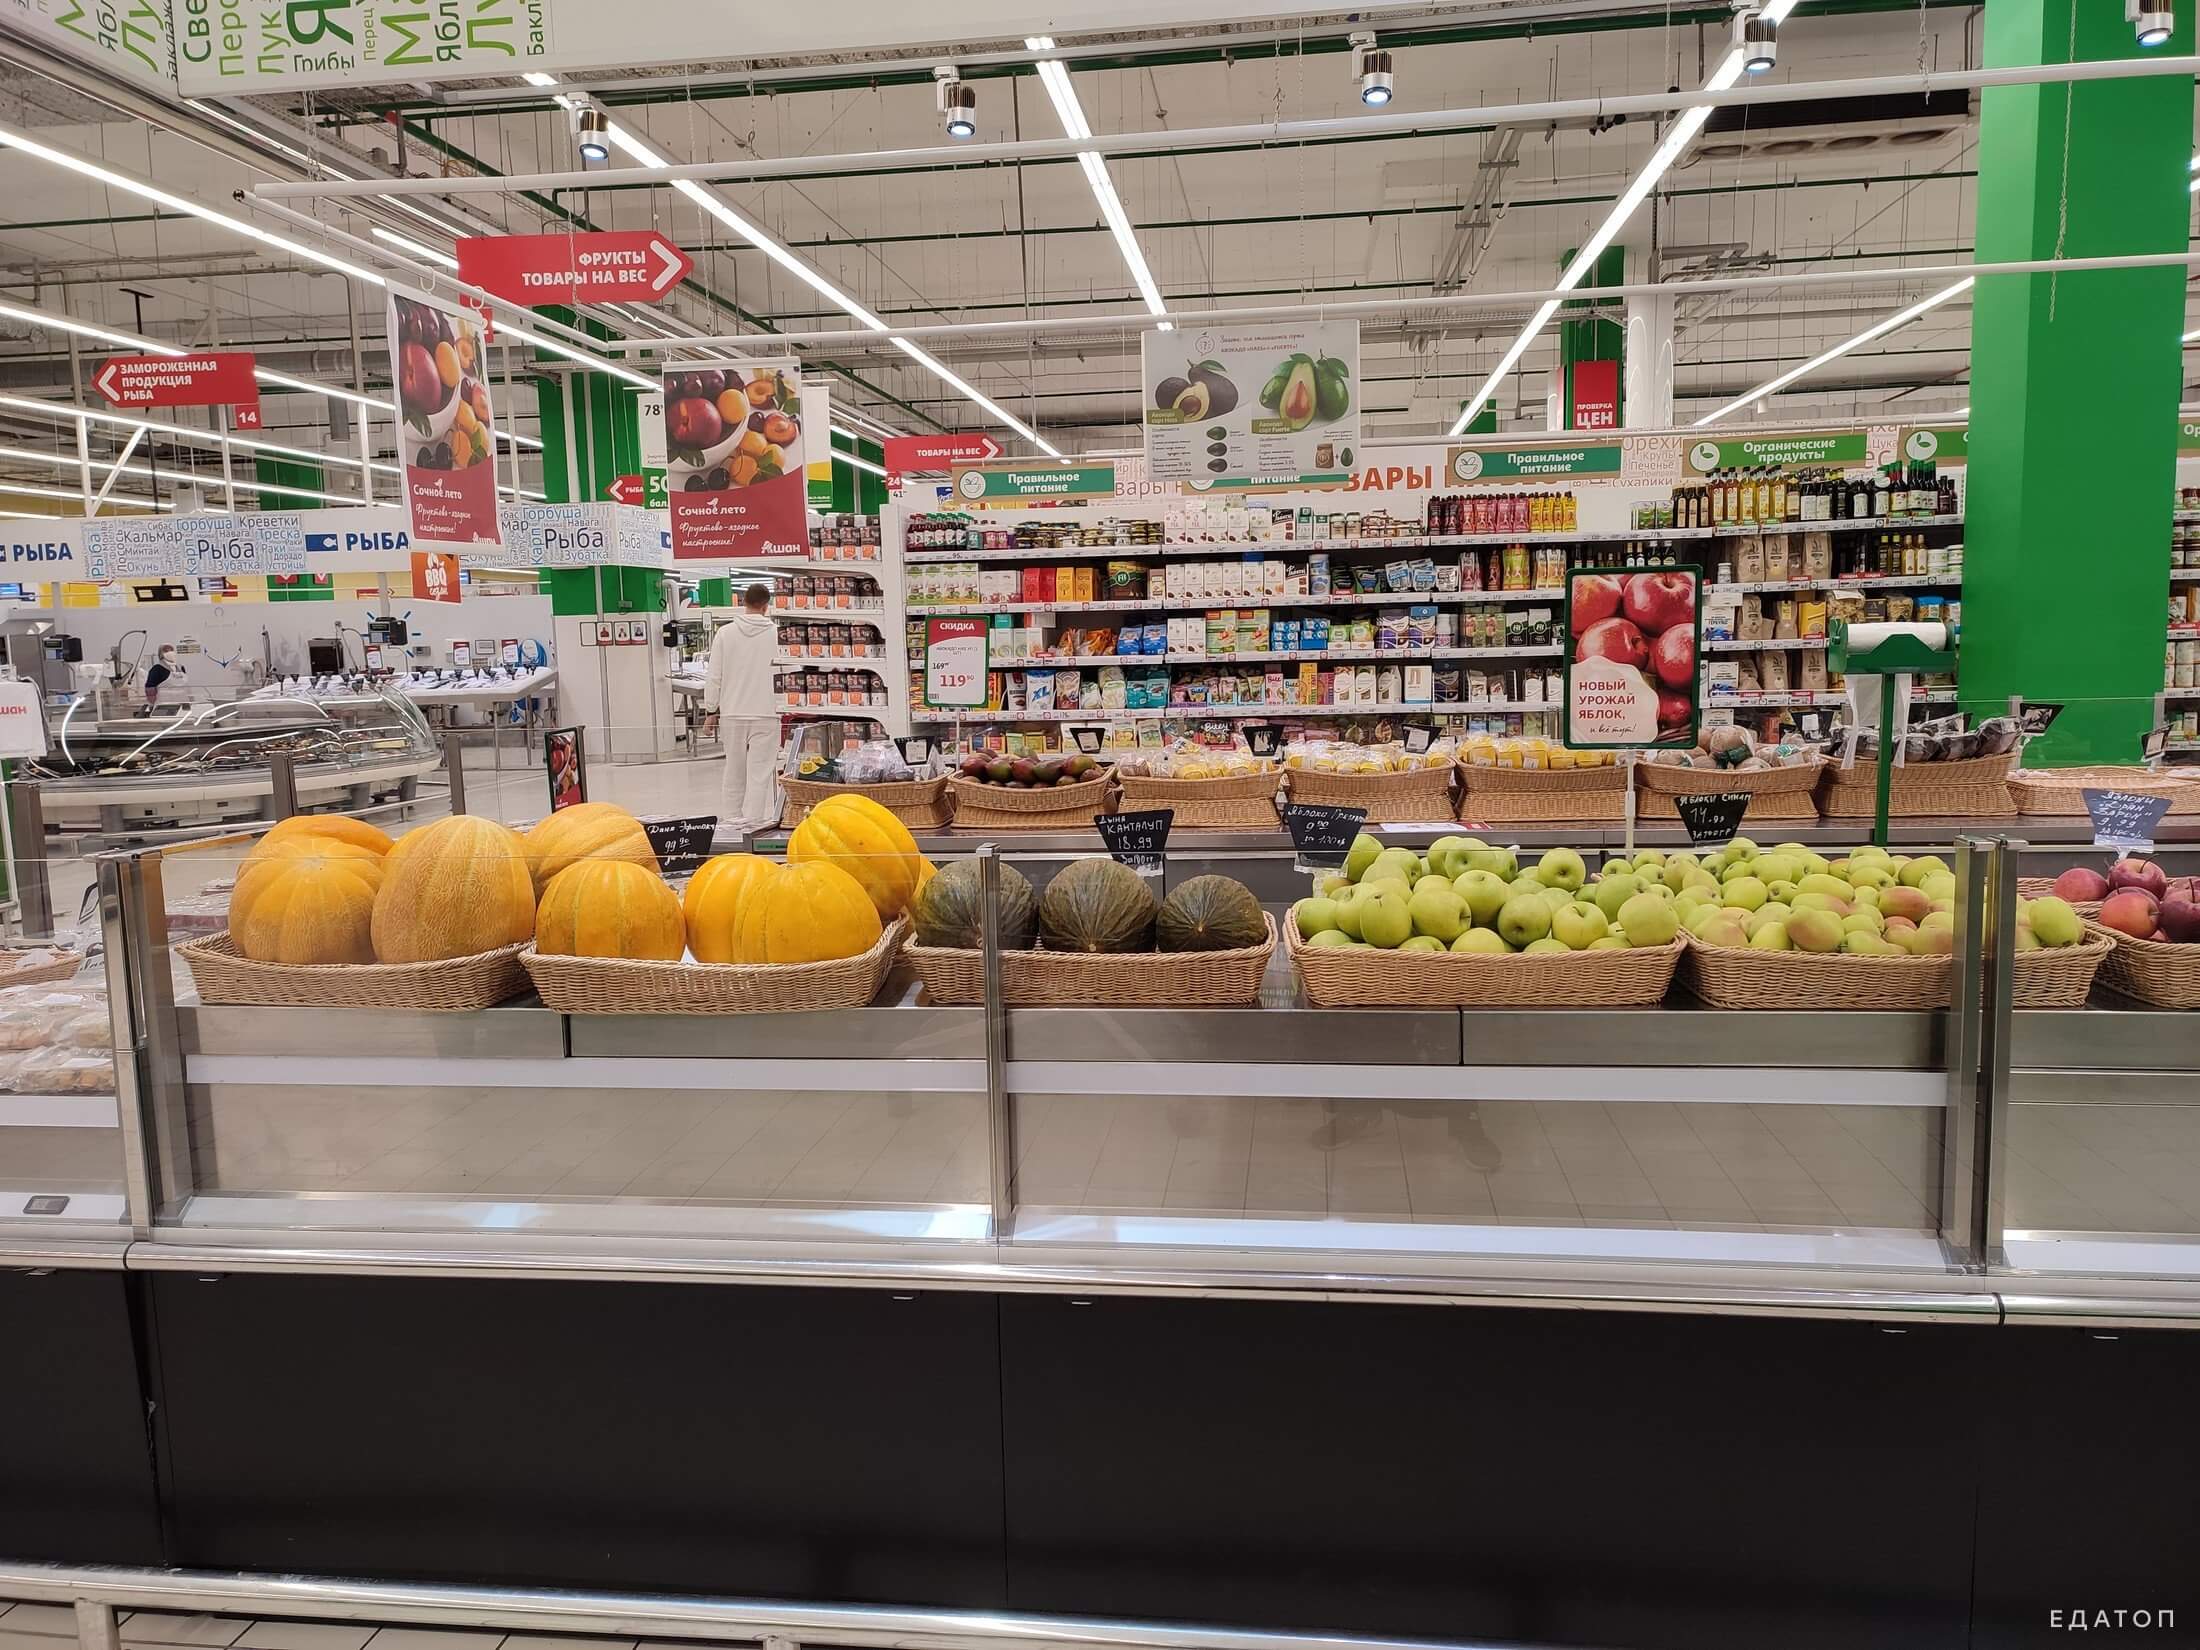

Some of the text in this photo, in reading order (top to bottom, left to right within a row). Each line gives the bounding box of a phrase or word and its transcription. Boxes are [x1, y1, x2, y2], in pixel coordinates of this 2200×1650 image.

[578, 250, 647, 267] ФРУКТЫ
[521, 268, 648, 287] ТОВАРЫ НА ВЕС
[120, 360, 218, 375] ЗАМОРОЖЕННАЯ
[121, 375, 193, 389] ПРОДУКЦИЯ
[123, 390, 154, 401] РЫБА
[1577, 402, 1613, 411] ПРОВЕРКА
[238, 411, 257, 423] 14
[1576, 411, 1613, 429] ЦЕН
[917, 448, 950, 457] ТОВАРЫ
[965, 447, 981, 455] ВЕС
[1743, 438, 1837, 454] Органические
[1507, 452, 1585, 466] Правильное
[1758, 450, 1825, 465] продукты
[1520, 462, 1572, 474] питание
[887, 476, 901, 487] 24
[1008, 473, 1080, 486] Правильное
[413, 484, 462, 500] Сочное лето
[1020, 483, 1069, 494] питание
[522, 506, 582, 521] Горбуша
[678, 505, 747, 516] Сочное лето
[147, 521, 173, 531] Сибас
[176, 519, 233, 532] Горбуша
[239, 516, 299, 528] Креветки
[567, 518, 600, 527] Навага
[679, 520, 761, 537] Фруктово-ягодное
[124, 530, 183, 545] Кальмар
[258, 529, 301, 541] Треска
[345, 531, 409, 552] РЫБА
[544, 527, 604, 550] Рыба
[197, 538, 256, 560] Рыба
[530, 527, 545, 566] Карп
[682, 534, 735, 551] настроение!
[761, 540, 801, 554] Ашан
[13, 543, 73, 562] РЫБА
[88, 533, 105, 577] Рыба
[125, 546, 160, 557] Минтай
[184, 538, 199, 577] Карп
[564, 549, 609, 562] Зубатка
[127, 561, 159, 574] Окунь
[218, 560, 260, 573] Зубатка
[425, 567, 448, 588] BBQ
[939, 622, 976, 632] СКИДКА
[940, 674, 966, 688] 119
[1579, 678, 1626, 692] НОВЫЙ
[1578, 692, 1636, 706] УРОЖАЙ
[1578, 709, 1626, 720] ЯБЛОК,
[1287, 805, 1328, 818] Яблоки
[1106, 819, 1164, 836] КАНТАЛУП
